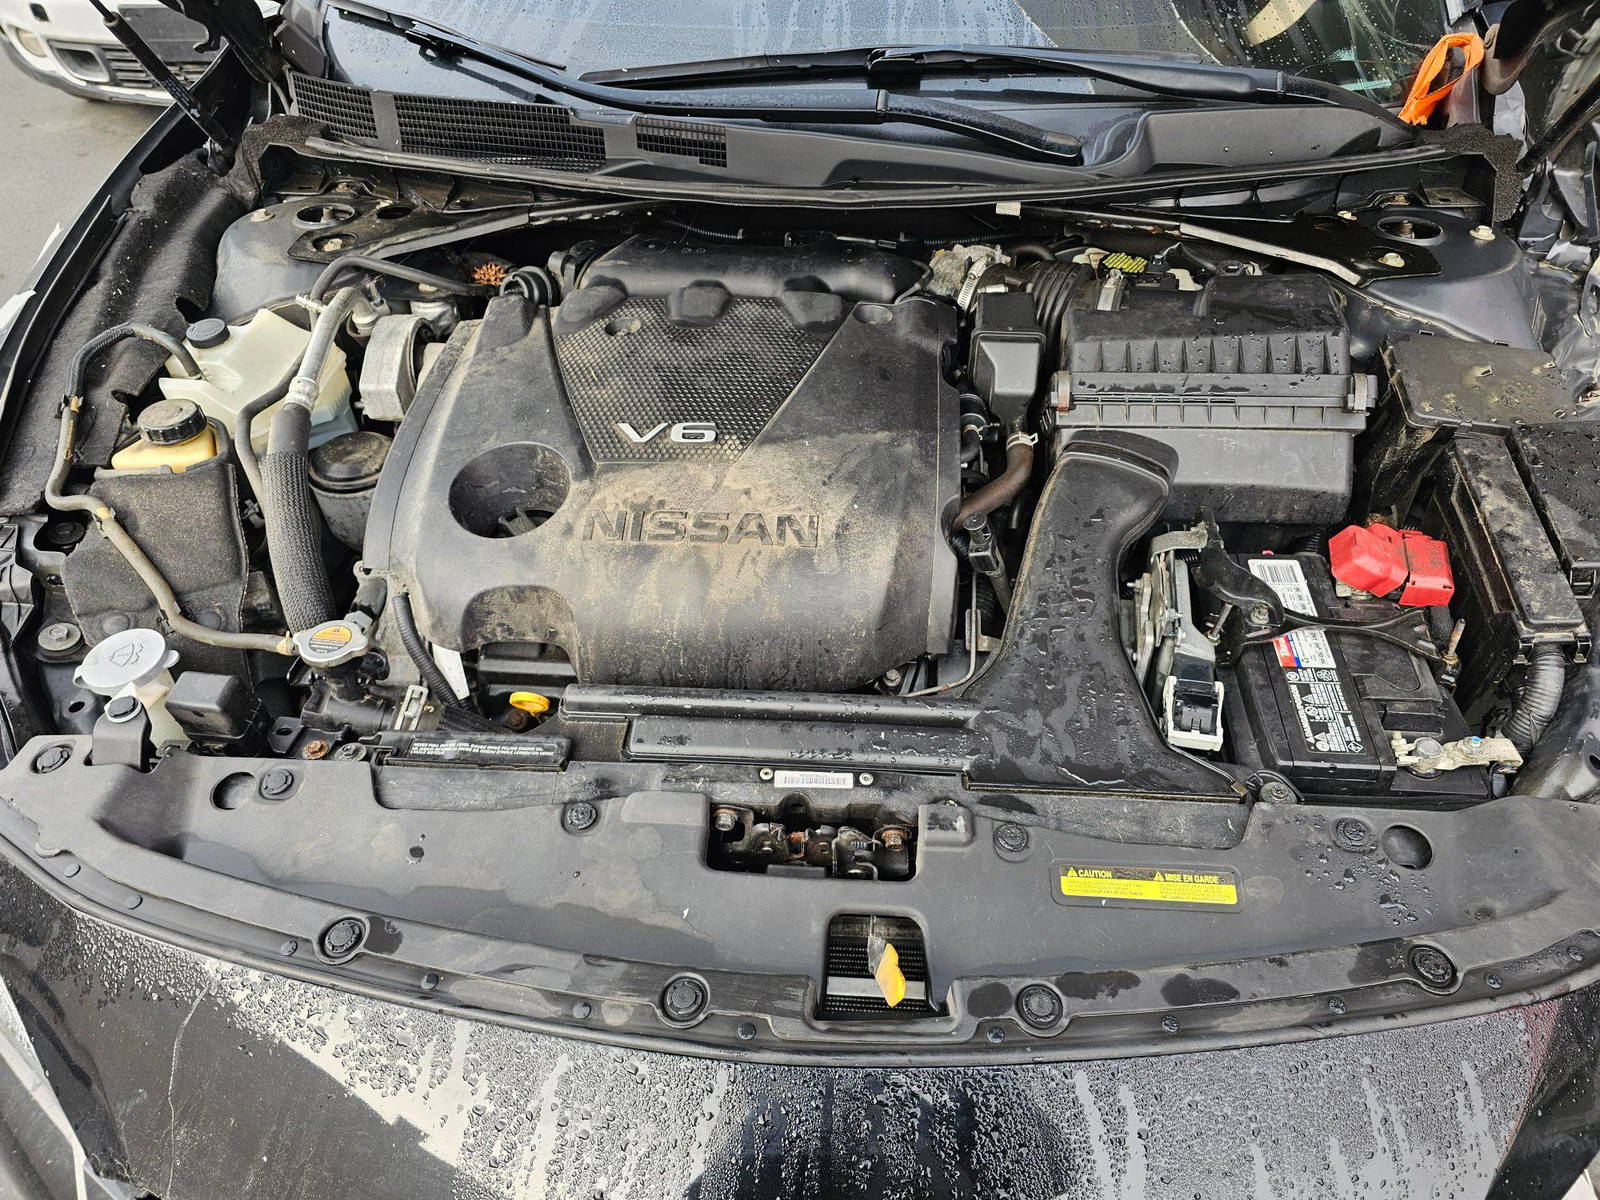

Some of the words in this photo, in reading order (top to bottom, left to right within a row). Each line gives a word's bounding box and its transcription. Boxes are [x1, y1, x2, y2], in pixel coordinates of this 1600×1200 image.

[617, 422, 717, 443] V6
[583, 510, 819, 547] NISSAN
[1078, 870, 1112, 879] CAUTION
[1165, 873, 1182, 881] MISE
[1183, 874, 1193, 883] EN
[1194, 875, 1219, 884] GARDE
